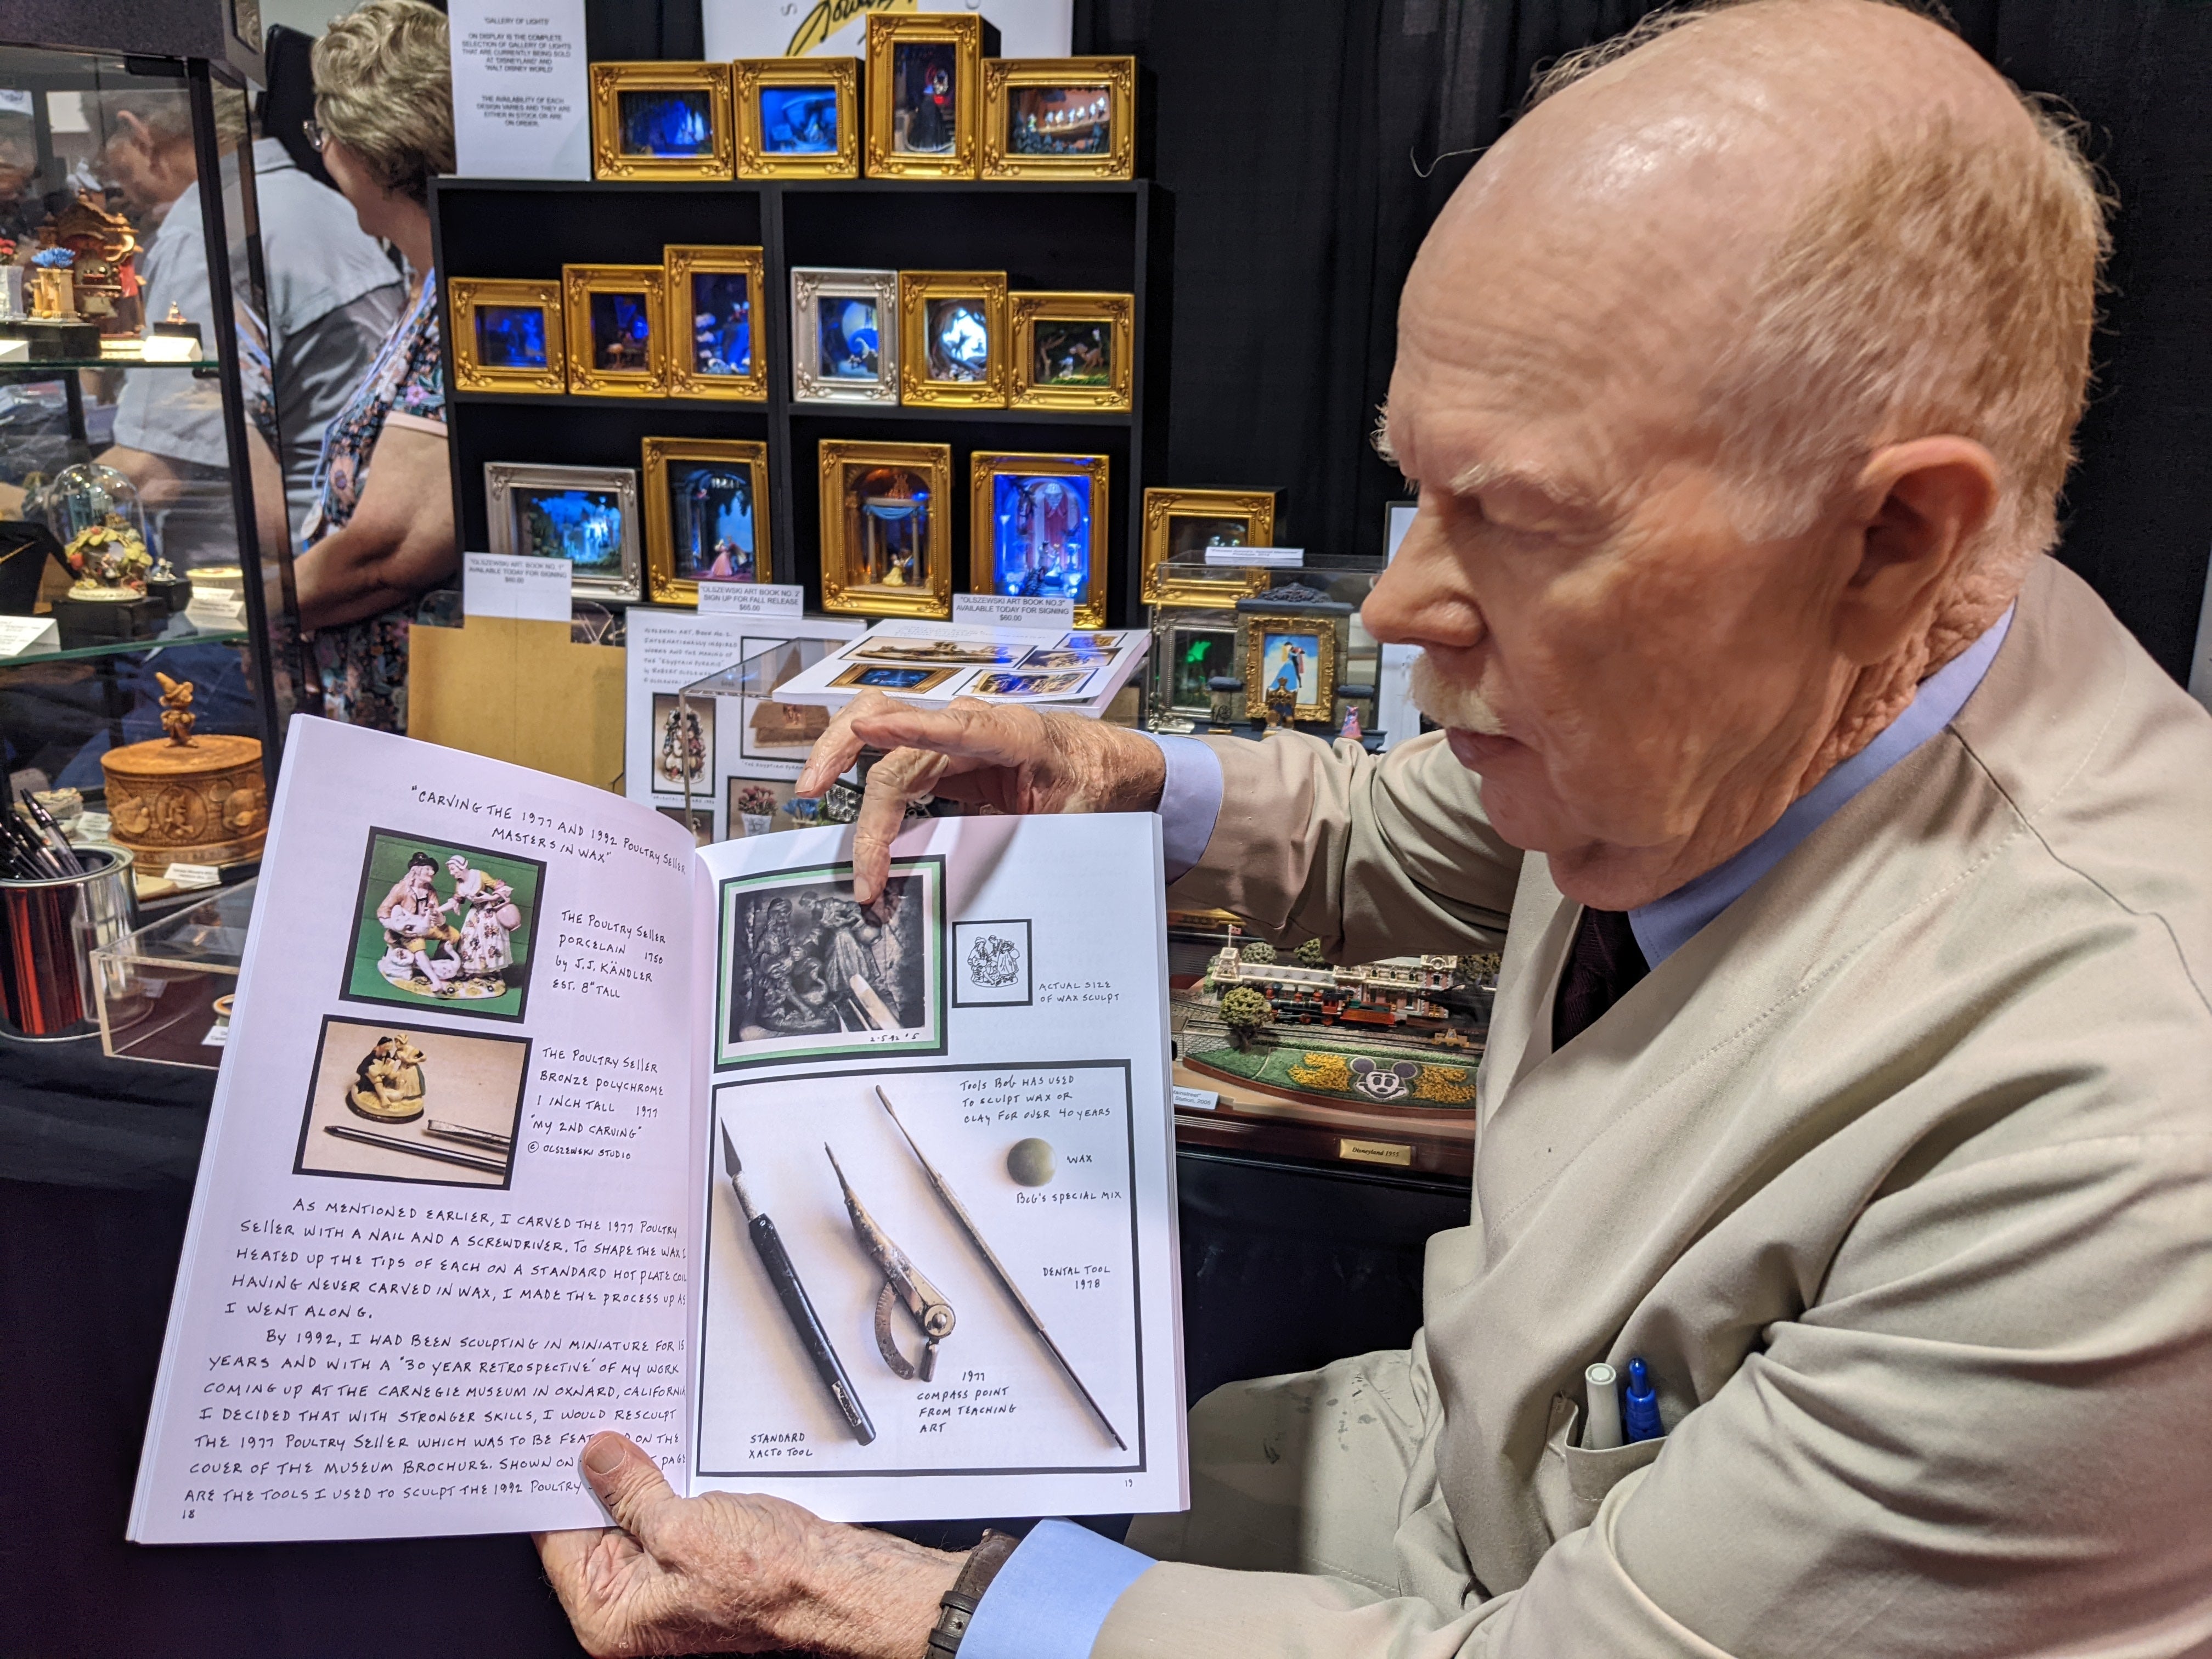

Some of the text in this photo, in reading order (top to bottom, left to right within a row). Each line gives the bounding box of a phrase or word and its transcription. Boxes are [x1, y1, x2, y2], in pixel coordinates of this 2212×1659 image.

[411, 785, 482, 813] "CARVING
[487, 805, 512, 819] THE
[522, 812, 553, 827] 1977
[557, 822, 584, 837] AND
[591, 829, 618, 845] 1992
[624, 838, 660, 864] POULTRY
[491, 828, 612, 864] MASTERS IN WAX"
[561, 910, 583, 923] THE
[588, 915, 632, 939] POULTRY
[559, 934, 663, 964] PORCELAIN 1750
[575, 958, 596, 972] J.J.
[600, 961, 652, 982] KÄNDLER
[552, 979, 620, 998] EST. 8" TALL
[1039, 981, 1081, 991] ACTUAL
[1040, 992, 1120, 1003] OF WAX SCULPT
[543, 1047, 566, 1059] THE
[573, 1049, 619, 1069] POULTRY
[540, 1070, 664, 1096] BRONZE POLYCHROME
[1023, 1076, 1043, 1086] HAS
[1049, 1075, 1074, 1084] USED
[549, 1094, 581, 1108] INCH
[586, 1100, 615, 1111] TALL
[636, 1105, 657, 1118] 1977
[962, 1098, 974, 1107] TO
[1026, 1094, 1051, 1102] WAX
[964, 1115, 991, 1126] CLAY
[998, 1110, 1018, 1121] FOR
[1024, 1109, 1050, 1119] OVER
[560, 1122, 583, 1133] 2ND
[598, 1149, 631, 1159] STUDIO
[1352, 1147, 1384, 1156] Disneyland
[1066, 1154, 1092, 1164] WAX
[1052, 1191, 1097, 1204] SPECIAL
[1102, 1192, 1122, 1200] MIX
[292, 1198, 678, 1239] AS MENTIONED EARLIER, I CARVED THE 1977 POULTRY
[1043, 1265, 1110, 1277] DENTAL TOOL
[1075, 1279, 1100, 1290] 1978
[225, 1302, 373, 1319] I WENT ALONG.
[297, 1330, 342, 1347] 1992,
[349, 1334, 362, 1345] I
[370, 1334, 402, 1346] HAD
[411, 1334, 452, 1347] BEEN
[460, 1338, 539, 1351] SCULPTING
[544, 1338, 562, 1350] IN
[569, 1339, 650, 1351] MINIATURE
[656, 1340, 674, 1352] FOR
[962, 1370, 985, 1382] 1977
[917, 1386, 1009, 1402] COMPASS POINT
[919, 1403, 1017, 1417] FROM TEACHING
[919, 1422, 946, 1433] ART
[750, 1432, 805, 1443] STANDARD
[749, 1447, 813, 1459] XACTO TOOL
[1125, 1479, 1133, 1487] 19
[182, 1509, 195, 1519] 18
